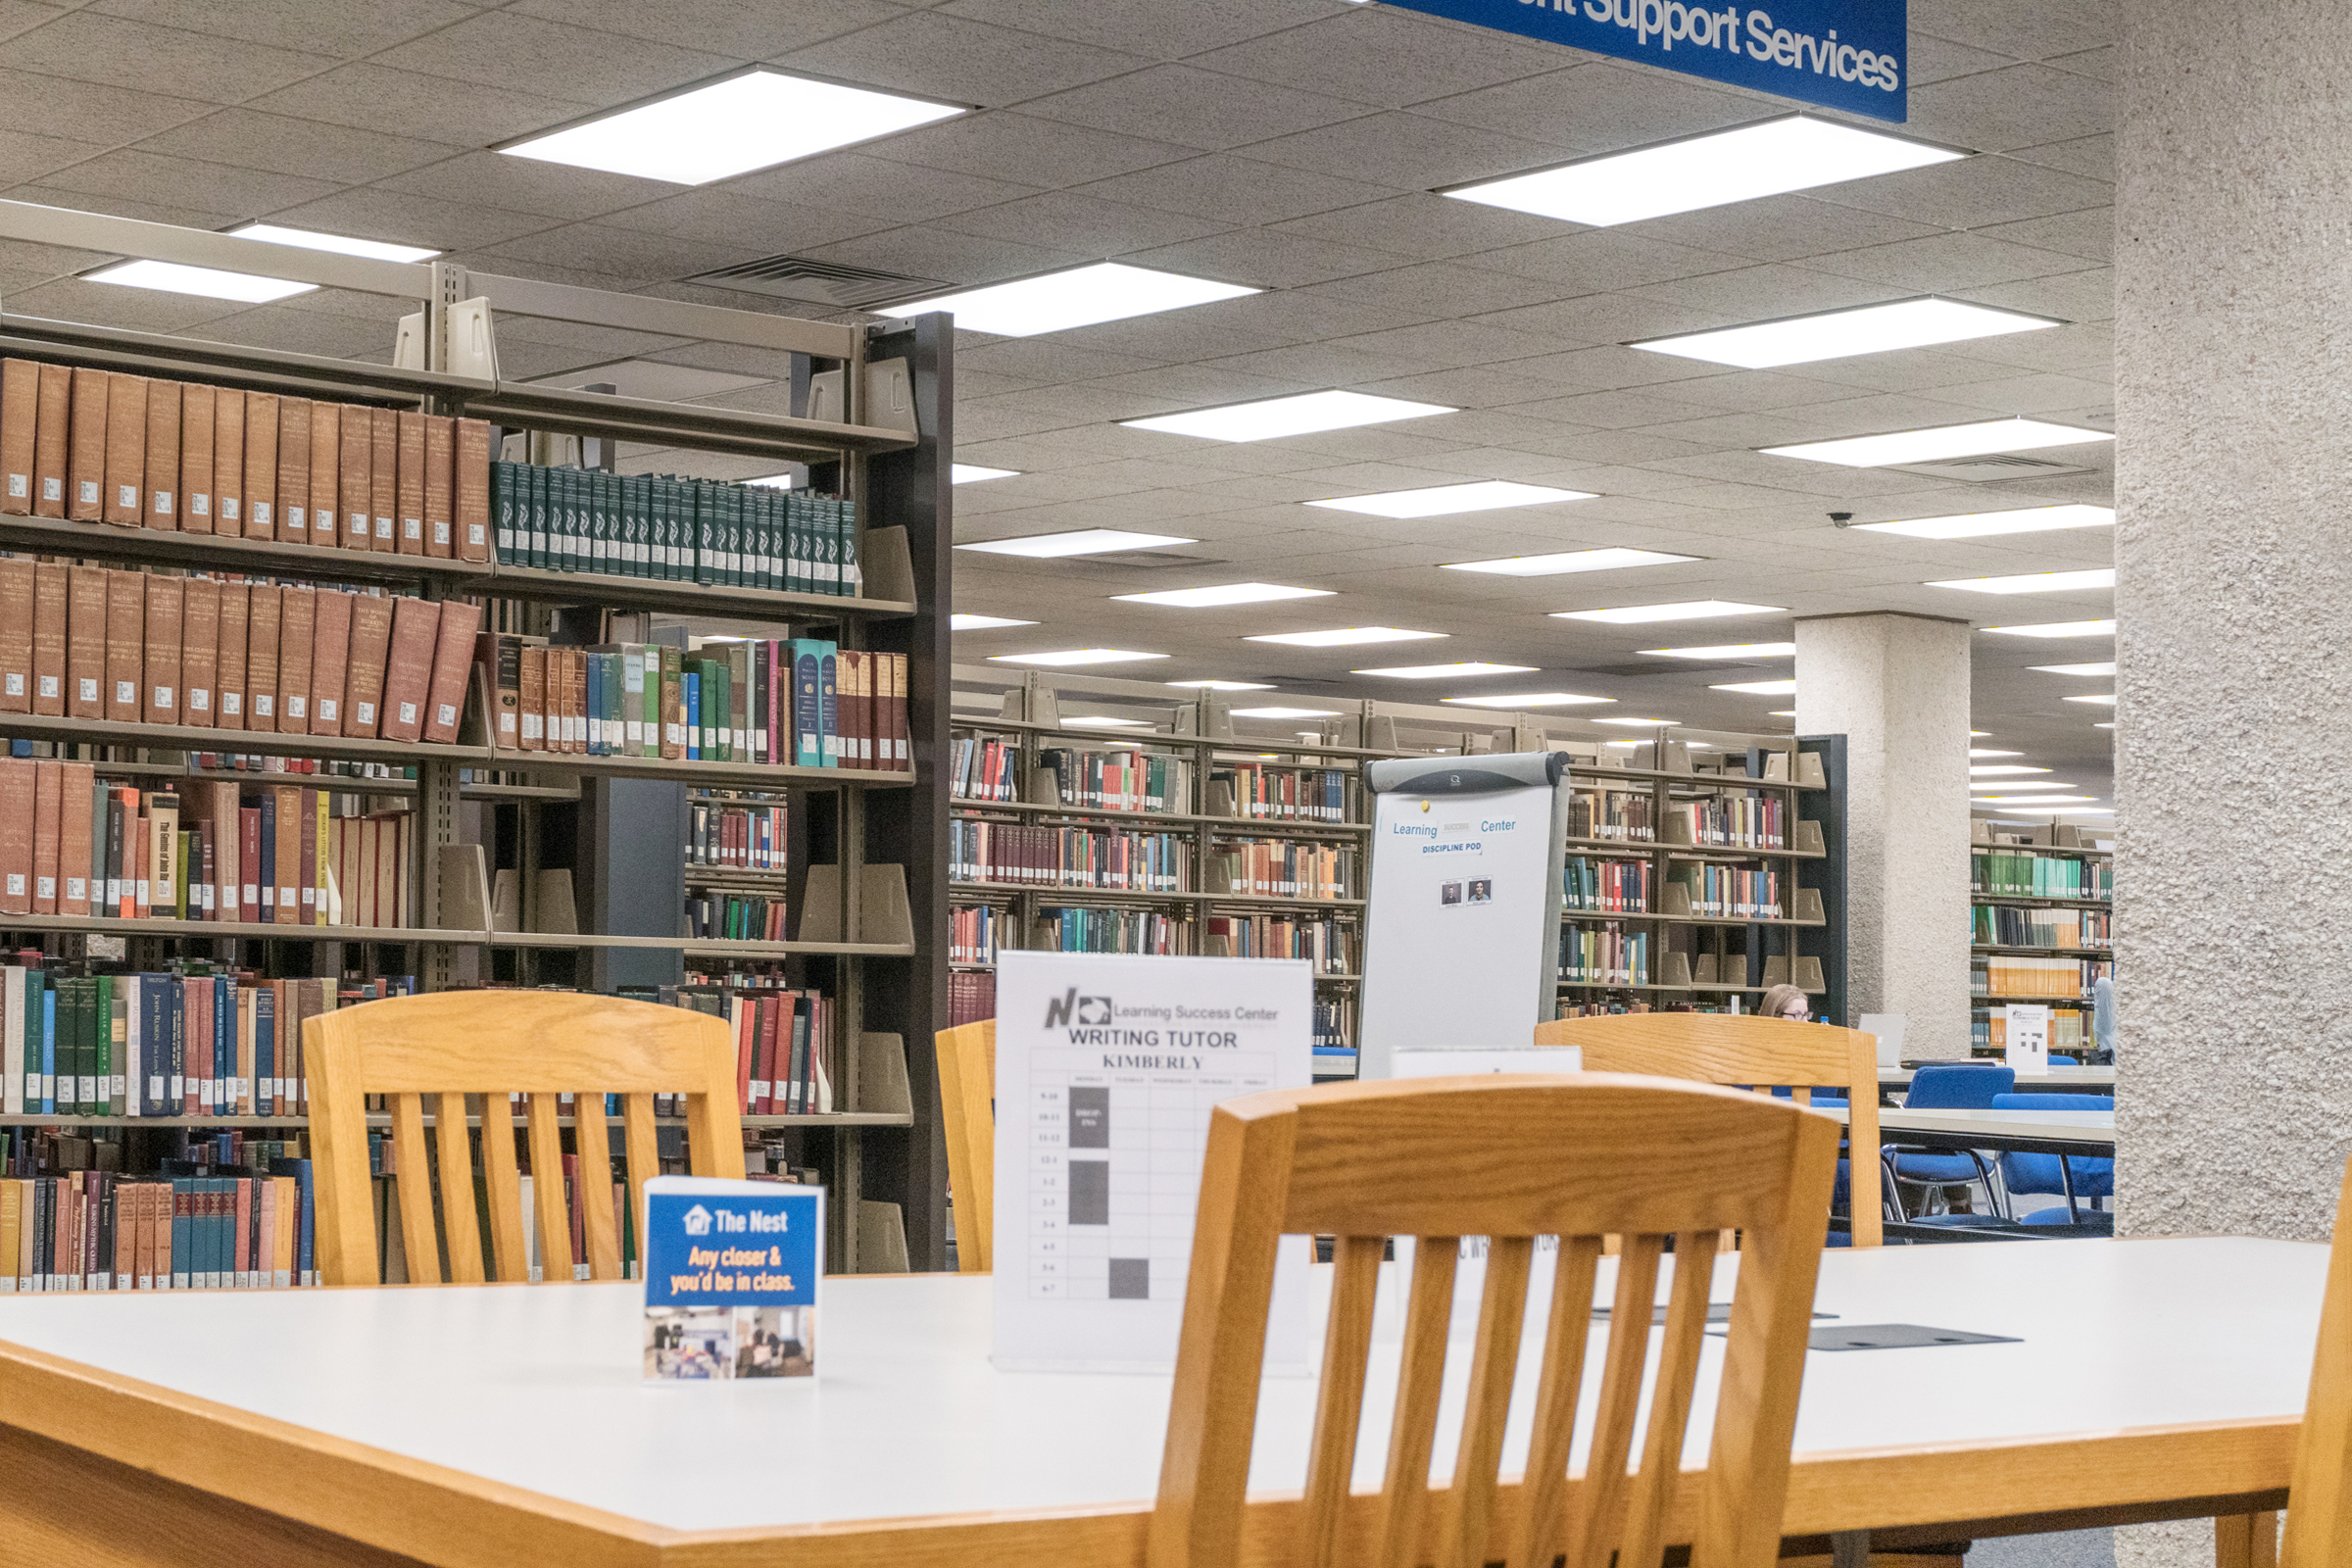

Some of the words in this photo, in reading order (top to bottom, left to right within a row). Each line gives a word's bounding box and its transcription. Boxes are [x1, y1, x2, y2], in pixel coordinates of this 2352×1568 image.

[1746, 11, 1898, 92] Services
[160, 822, 170, 832] The
[1394, 823, 1438, 839] Learning
[1481, 819, 1516, 832] Center
[160, 833, 170, 852] Genius
[1423, 844, 1463, 854] DISCIPLINE
[1465, 842, 1482, 851] POD
[160, 859, 170, 872] John
[1114, 1004, 1171, 1021] Learning
[1175, 1005, 1231, 1020] Success
[1235, 1006, 1278, 1020] Center
[1068, 1029, 1159, 1047] WRITING
[1166, 1031, 1237, 1048] TUTOR
[1103, 1054, 1202, 1070] KIMBERLY
[714, 1209, 746, 1233] The
[750, 1210, 788, 1233] Nest
[688, 1246, 719, 1270] Any
[720, 1247, 767, 1266] closer
[769, 1246, 781, 1266] &
[670, 1271, 712, 1296] you'd
[714, 1271, 733, 1292] be
[736, 1271, 751, 1292] in
[753, 1271, 795, 1292] class.
